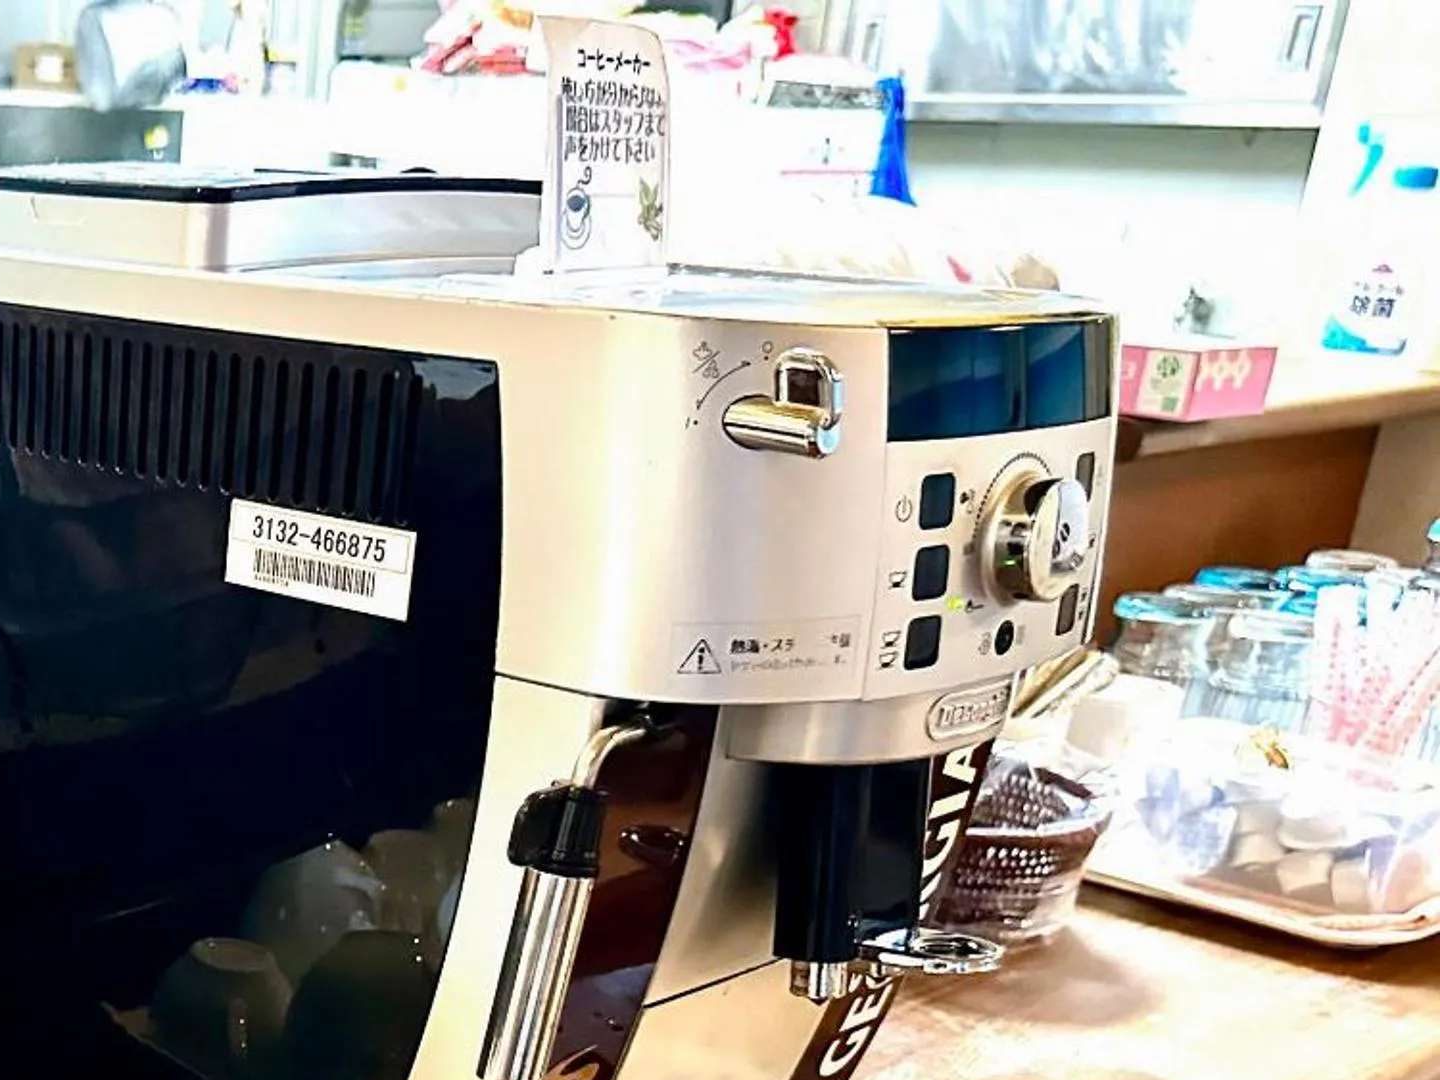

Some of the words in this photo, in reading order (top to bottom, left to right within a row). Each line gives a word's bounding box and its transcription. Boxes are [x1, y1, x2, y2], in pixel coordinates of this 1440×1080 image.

[577, 49, 651, 75] コーヒーメーカー
[252, 516, 386, 563] 3132-466875
